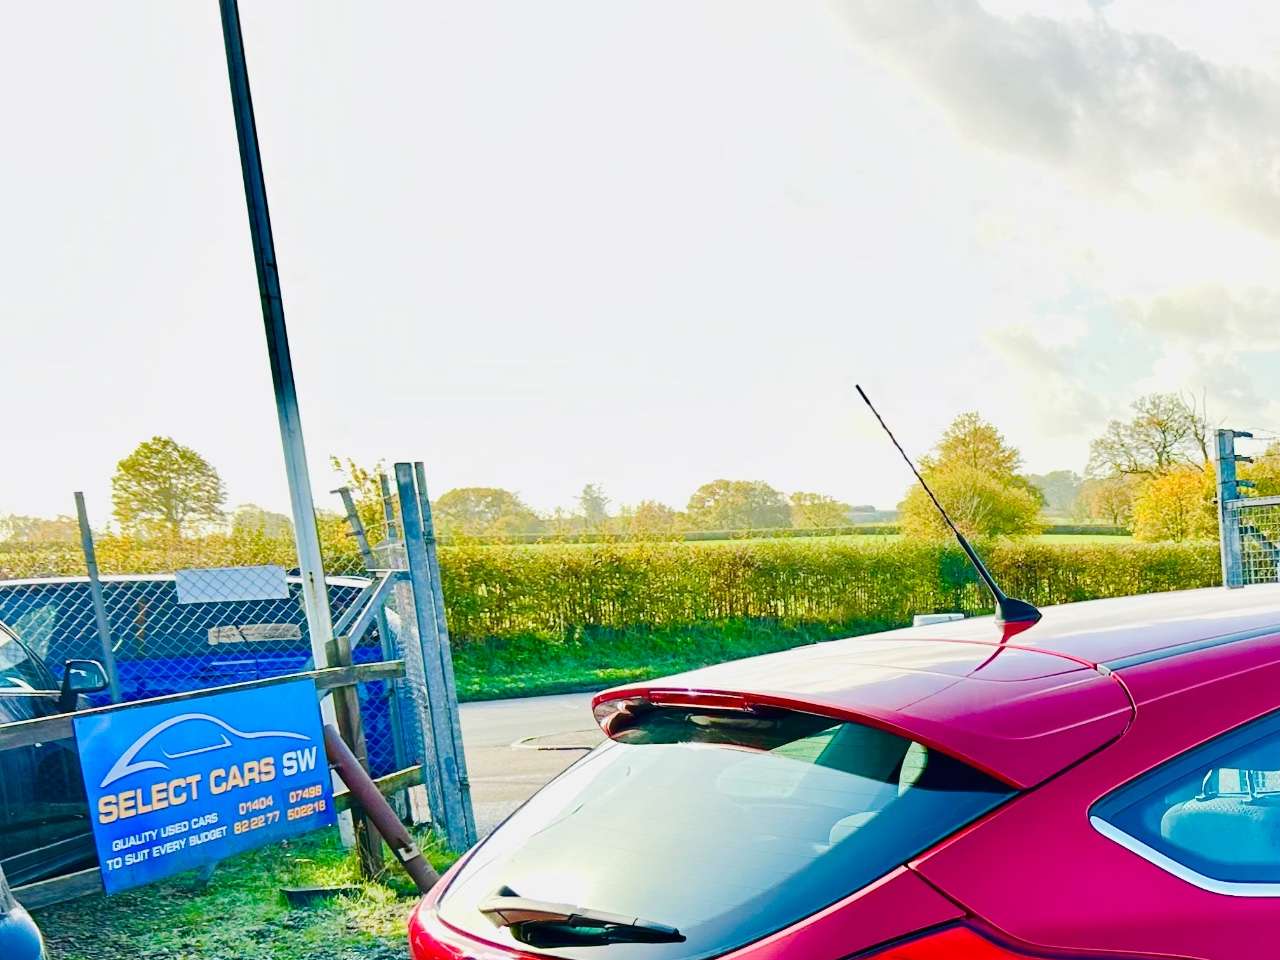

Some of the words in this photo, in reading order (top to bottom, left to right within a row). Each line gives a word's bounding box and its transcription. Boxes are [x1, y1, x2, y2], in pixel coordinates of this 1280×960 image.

[98, 774, 202, 825] SELECT
[208, 757, 276, 795] CARS
[281, 746, 317, 777] SW
[238, 795, 273, 815] 01404
[106, 856, 122, 871] TO
[124, 849, 150, 866] SUIT
[152, 838, 187, 858] EVERY
[189, 826, 228, 847] BUDGET
[112, 829, 158, 852] QUALITY
[160, 821, 189, 838] USED
[191, 812, 219, 829] CARS
